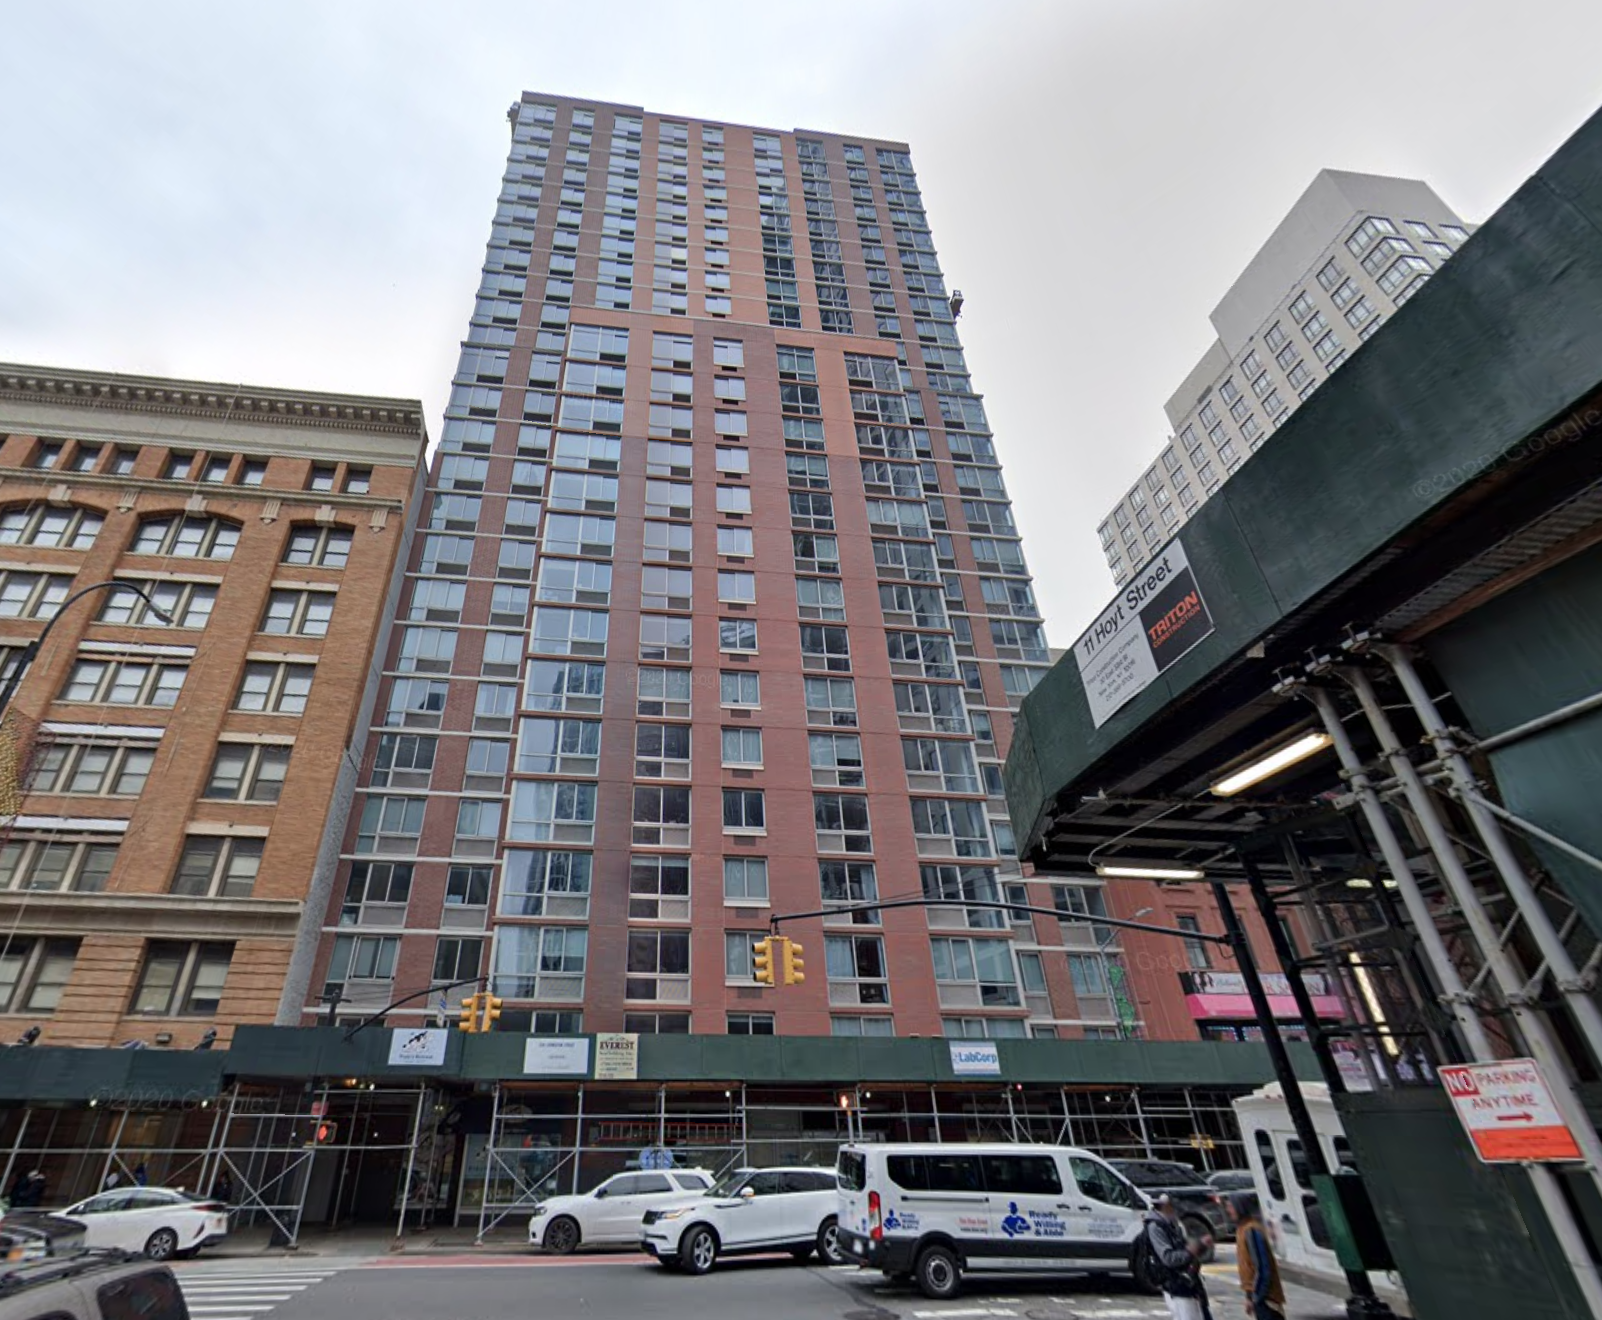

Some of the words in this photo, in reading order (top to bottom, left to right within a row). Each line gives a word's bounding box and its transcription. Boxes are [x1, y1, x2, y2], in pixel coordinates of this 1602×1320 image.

[1095, 605, 1125, 644] Hoyt
[1126, 557, 1173, 611] Street
[1148, 590, 1199, 640] TRITON
[1153, 604, 1201, 648] CONSTRUCTION
[599, 1041, 635, 1050] EVEREST
[959, 1051, 997, 1064] LabCorp
[1445, 1071, 1476, 1092] NO
[1477, 1068, 1538, 1086] PARKING
[1472, 1093, 1539, 1110] ANYTIME
[1029, 1210, 1058, 1220] Ready
[1034, 1220, 1067, 1230] Willing
